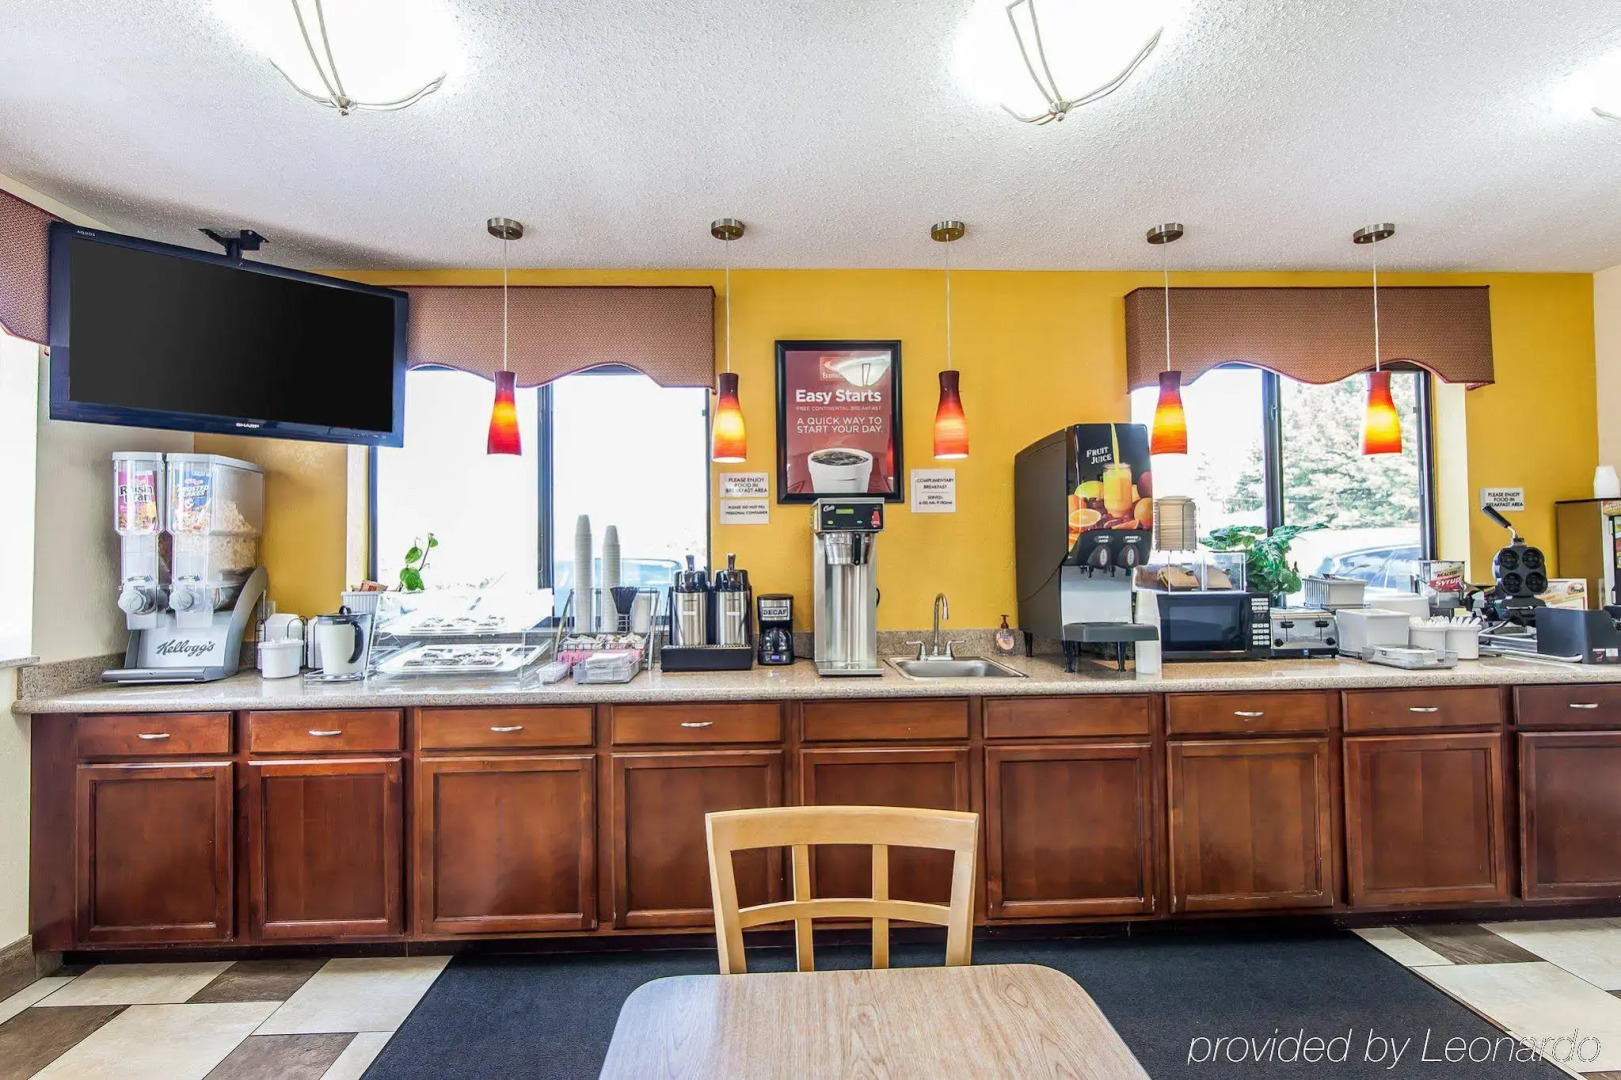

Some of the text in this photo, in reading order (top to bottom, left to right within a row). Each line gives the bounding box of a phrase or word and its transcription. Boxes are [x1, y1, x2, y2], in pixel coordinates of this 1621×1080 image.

[796, 389, 882, 405] Easy Starts
[797, 416, 882, 425] A QUICK WAY TO
[797, 425, 884, 434] START YOUR DAY.
[1086, 446, 1109, 458] FRUIT
[1091, 453, 1112, 465] JUICE
[119, 485, 154, 495] Risin
[156, 639, 216, 657] Kellogg's
